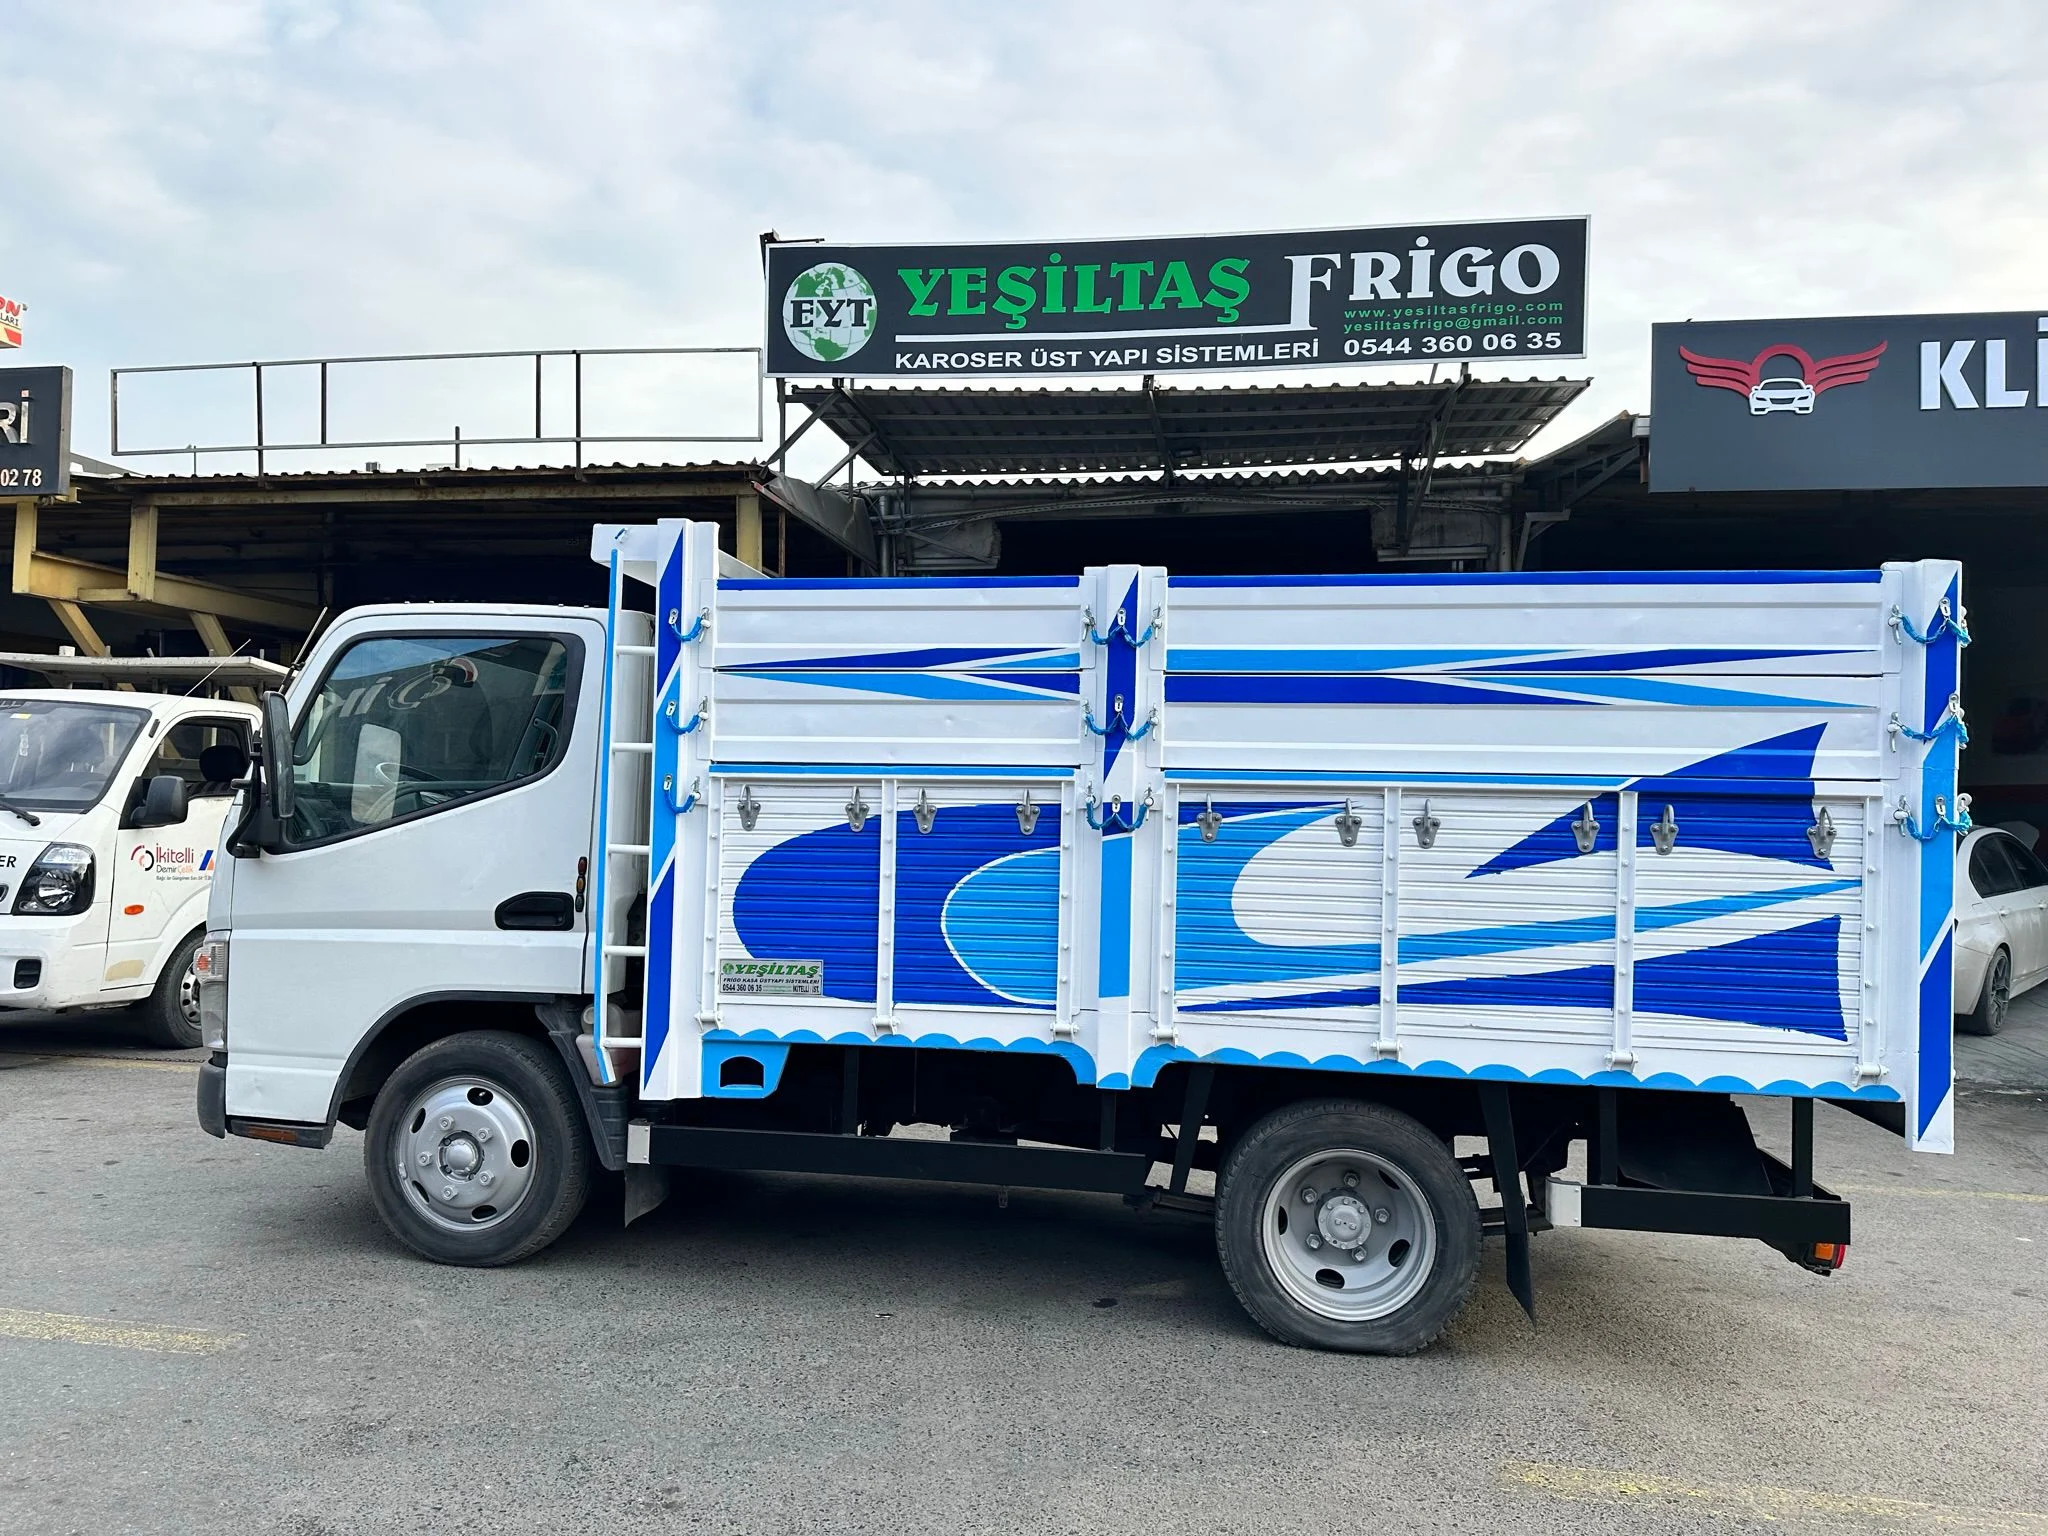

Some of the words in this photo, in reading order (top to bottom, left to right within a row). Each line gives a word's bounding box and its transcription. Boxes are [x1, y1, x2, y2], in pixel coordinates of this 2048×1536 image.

[897, 252, 1251, 330] YEŞİLTAŞ
[1284, 236, 1560, 331] FRİGO
[790, 298, 872, 328] EYT
[1344, 302, 1563, 319] www.yesiltasfrigo.com
[1344, 315, 1563, 334] yesiltasfrigo@gmail.com
[895, 351, 1022, 369] KAROSER
[1031, 348, 1082, 367] ÜST
[1089, 348, 1148, 367] YAPI
[1156, 338, 1319, 364] SİSTEMLERİ
[1344, 337, 1412, 356] 0544
[1421, 335, 1473, 354] 360
[1482, 333, 1517, 351] 06
[1526, 332, 1562, 349] 35
[0, 468, 19, 487] 02
[22, 468, 42, 487] 78
[156, 864, 177, 874] Demir
[735, 962, 820, 978] YEŞİLTAŞ
[722, 983, 736, 992] 0544
[736, 983, 747, 992] 360
